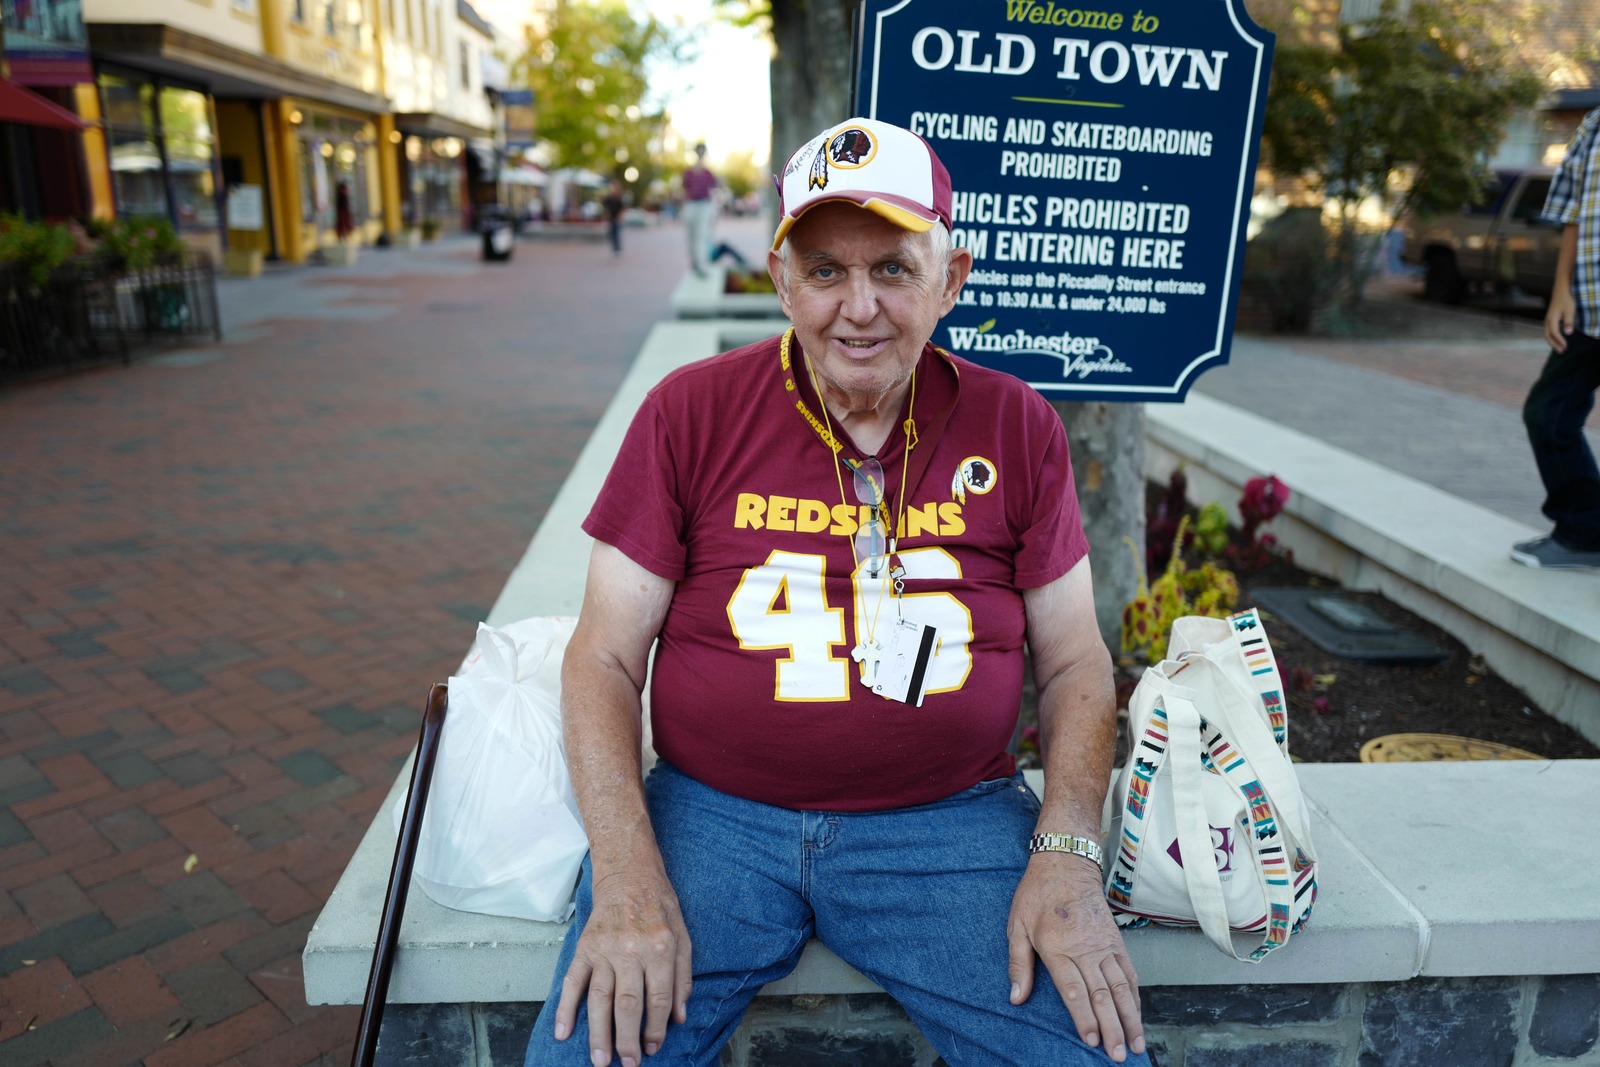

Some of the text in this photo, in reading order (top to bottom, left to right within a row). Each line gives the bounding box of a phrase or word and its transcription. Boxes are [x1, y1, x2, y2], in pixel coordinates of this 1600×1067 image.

[1006, 0, 1160, 33] Welcome to
[911, 26, 1229, 91] OLD TOWN
[910, 111, 1213, 157] CYCLING AND SKATEBOARDING
[1000, 150, 1122, 182] PROHIBITED
[951, 191, 1190, 235] HICLES PROHIBITED
[951, 228, 1186, 270] OM ENTERING HERE
[967, 269, 1206, 295] ehicles use the Piccadilly Street entrance
[980, 290, 993, 306] to
[996, 291, 1029, 308] 10:30
[1030, 293, 1056, 309] A.M.
[1058, 294, 1069, 309] &
[1071, 294, 1106, 311] under
[1106, 296, 1147, 314] 24,000
[1147, 297, 1167, 313] lbs
[947, 325, 1100, 355] Winchester
[1063, 353, 1133, 379] Virginia
[795, 400, 844, 454] REDSKINS
[726, 546, 974, 703] 46
